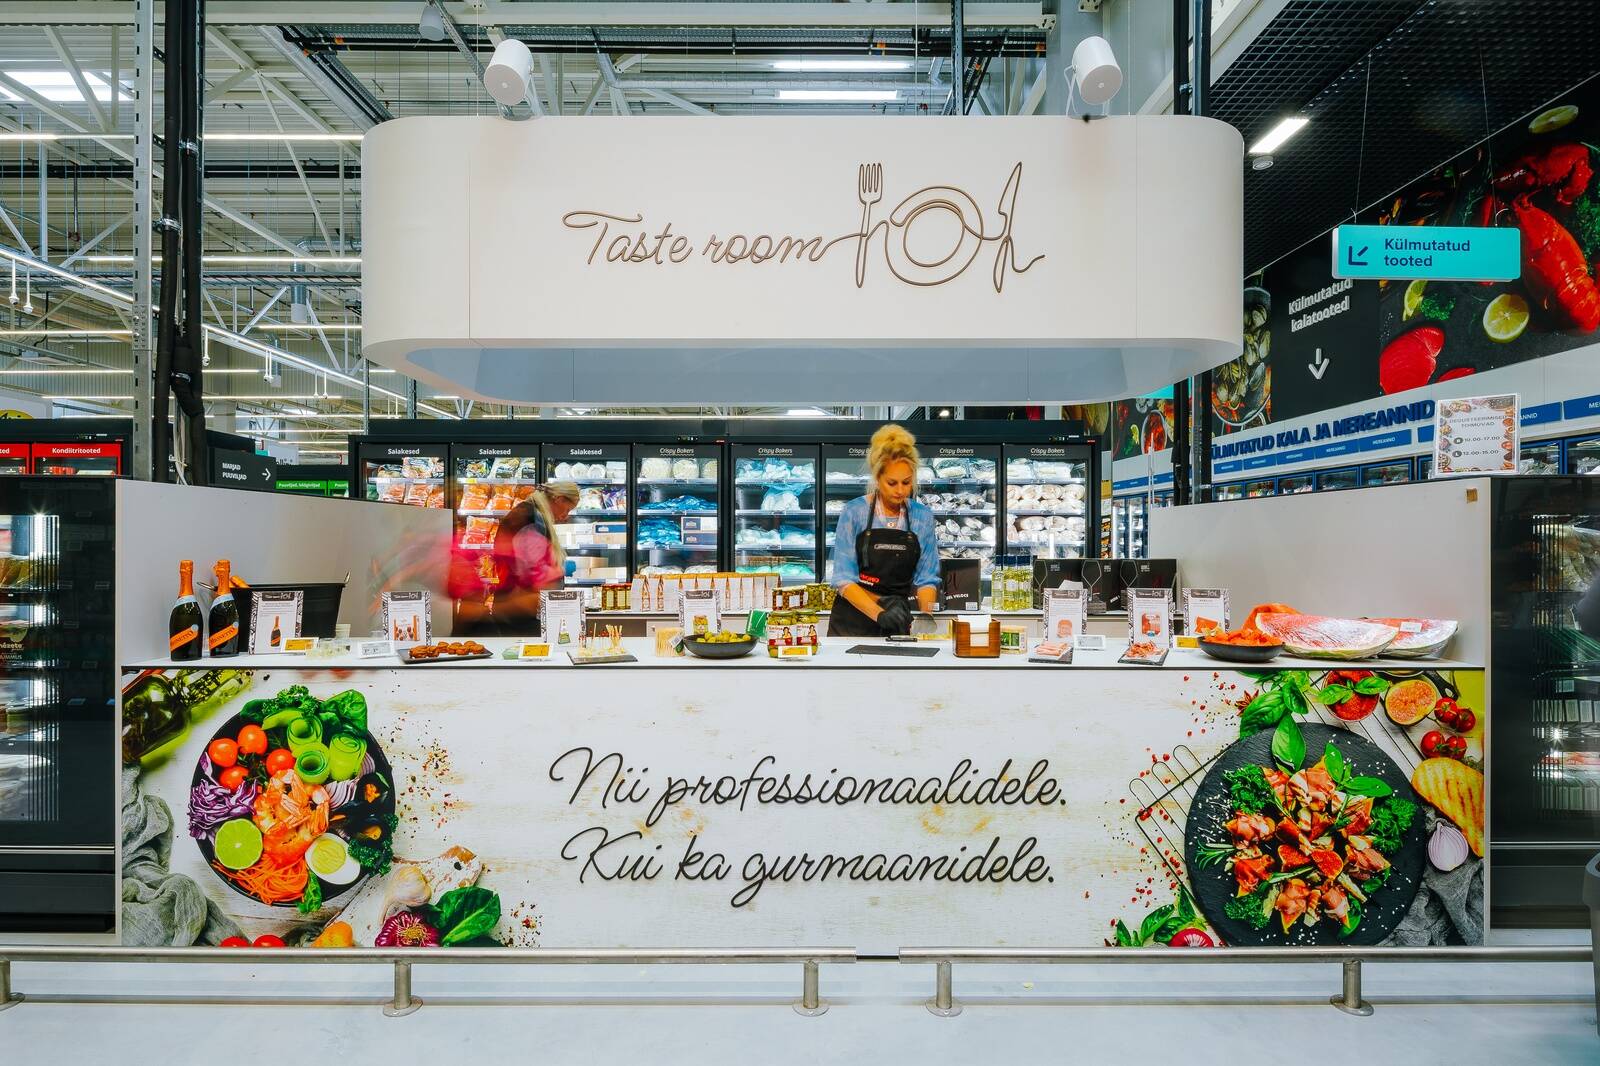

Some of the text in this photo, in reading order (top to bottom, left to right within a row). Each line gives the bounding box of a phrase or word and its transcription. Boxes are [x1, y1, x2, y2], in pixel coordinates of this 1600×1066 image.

[563, 210, 830, 265] Taste room
[1384, 238, 1471, 252] Külmutatud
[1383, 255, 1433, 267] tooted
[1288, 278, 1353, 315] Külmutatud
[1291, 296, 1350, 332] kalatooted
[1276, 427, 1310, 448] KALA
[1312, 422, 1331, 441] JA
[1332, 399, 1436, 436] MEREANNID
[659, 447, 675, 455] Crispy
[758, 447, 774, 455] Crispy
[848, 447, 865, 455] Crispy
[939, 447, 955, 455] Crispy
[1030, 447, 1046, 455] Crispy
[549, 746, 1067, 827] Nii professionaalidele.
[560, 826, 1055, 908] Kui ka gurmaanidele.
